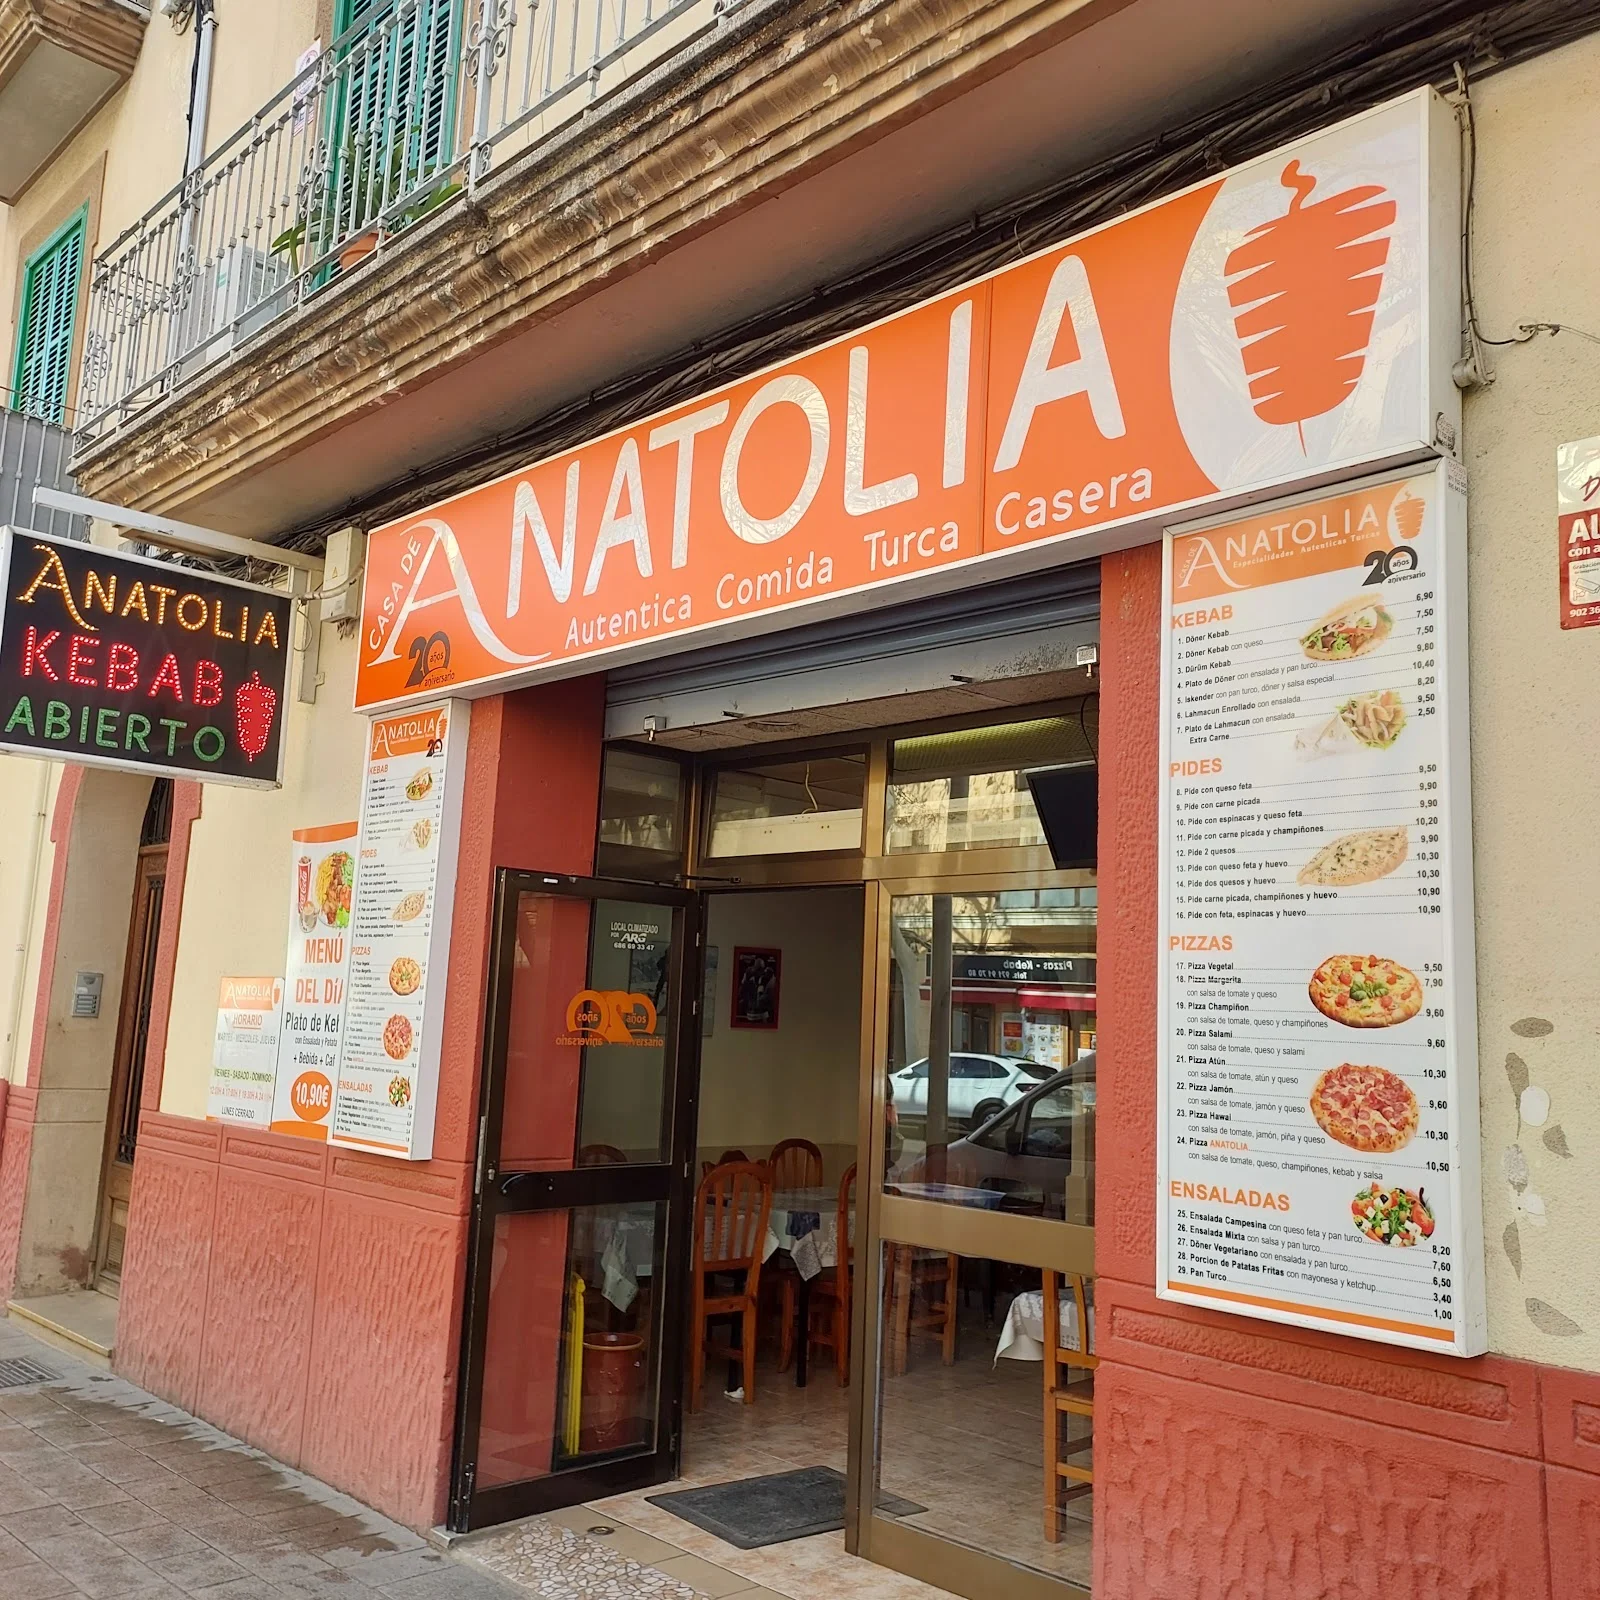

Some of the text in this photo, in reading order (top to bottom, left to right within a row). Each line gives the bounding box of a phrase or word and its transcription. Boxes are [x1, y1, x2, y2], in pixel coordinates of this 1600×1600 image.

[367, 254, 1126, 667] ANATOLIA
[1177, 503, 1379, 589] ANATOLIA
[1233, 550, 1294, 568] Especialidades
[1300, 537, 1347, 554] Autenticas
[1568, 546, 1591, 558] con
[564, 468, 1154, 650] Autentica Comida Turca Casera
[1362, 545, 1418, 587] 20
[1392, 558, 1409, 568] años
[1387, 571, 1426, 584] aniversario
[16, 544, 279, 649] ANATOLIA
[369, 536, 421, 650] CASA DE
[1172, 605, 1233, 629] KEBAB
[1185, 634, 1206, 643] Döner
[1207, 629, 1229, 639] Kebab
[1416, 591, 1433, 601] 6,90
[1569, 607, 1587, 618] 902
[404, 631, 450, 688] 20
[1185, 663, 1207, 673] Dürüm
[1209, 659, 1231, 669] Kebab
[1416, 624, 1434, 635] 7,50
[21, 625, 224, 707] KEBAB
[1184, 708, 1219, 717] Lahmacun
[1221, 702, 1255, 712] Enrollado
[1270, 695, 1300, 706] ensalada
[1417, 676, 1435, 686] 8,20
[4, 695, 226, 762] ABIERTO
[373, 718, 435, 756] ANATOLIA
[1189, 736, 1207, 744] Extra
[1417, 706, 1435, 716] 2,50
[370, 764, 389, 776] KEBAB
[1170, 758, 1222, 777] PIDES
[361, 849, 377, 859] PIDES
[1187, 848, 1202, 856] Pide
[1204, 847, 1208, 855] 2
[1210, 847, 1236, 856] quesos
[1420, 834, 1438, 843] 9,90
[1187, 895, 1202, 903] Pide
[1225, 893, 1251, 902] picada,
[1253, 892, 1304, 901] champiñones
[1306, 893, 1310, 901] y
[1417, 887, 1440, 896] 10,90
[611, 922, 659, 934] LOCAL CLIMATIZADO
[620, 932, 647, 944] ARG
[305, 931, 343, 963] MENÚ
[352, 947, 371, 956] PIZZAS
[1170, 935, 1232, 951] PIZZAS
[1207, 962, 1233, 971] Vegetal
[1423, 963, 1442, 972] 9,50
[224, 981, 271, 1009] ANATOLIA
[295, 978, 319, 1003] DEL
[233, 1014, 263, 1026] HORARIO
[285, 1011, 307, 1032] Plato
[310, 1013, 321, 1032] de
[1176, 1001, 1186, 1009] 19.
[1208, 1002, 1249, 1011] Champiñon
[1425, 1008, 1444, 1018] 9,60
[1217, 1016, 1226, 1024] de
[1227, 1017, 1251, 1025] tomate,
[1275, 1019, 1280, 1027] y
[1281, 1018, 1328, 1028] champiñones
[302, 1036, 321, 1046] Ensalada
[299, 1052, 318, 1065] Bebida
[295, 1082, 329, 1108] 10,90€
[338, 1080, 373, 1093] ENSALADAS
[1176, 1081, 1447, 1110] 22. Pizza Jamón 9,60
[221, 1106, 255, 1121] LUNES CERRADO
[1176, 1135, 1449, 1172] 24. Pizza ANATOLIA 10,50
[1171, 1181, 1290, 1211] ENSALADAS
[1177, 1209, 1450, 1255] 25. Ensalada Campesina con queso feta y pan turco 8,20
[1177, 1265, 1452, 1319] 29. Pan Turco 1,00
